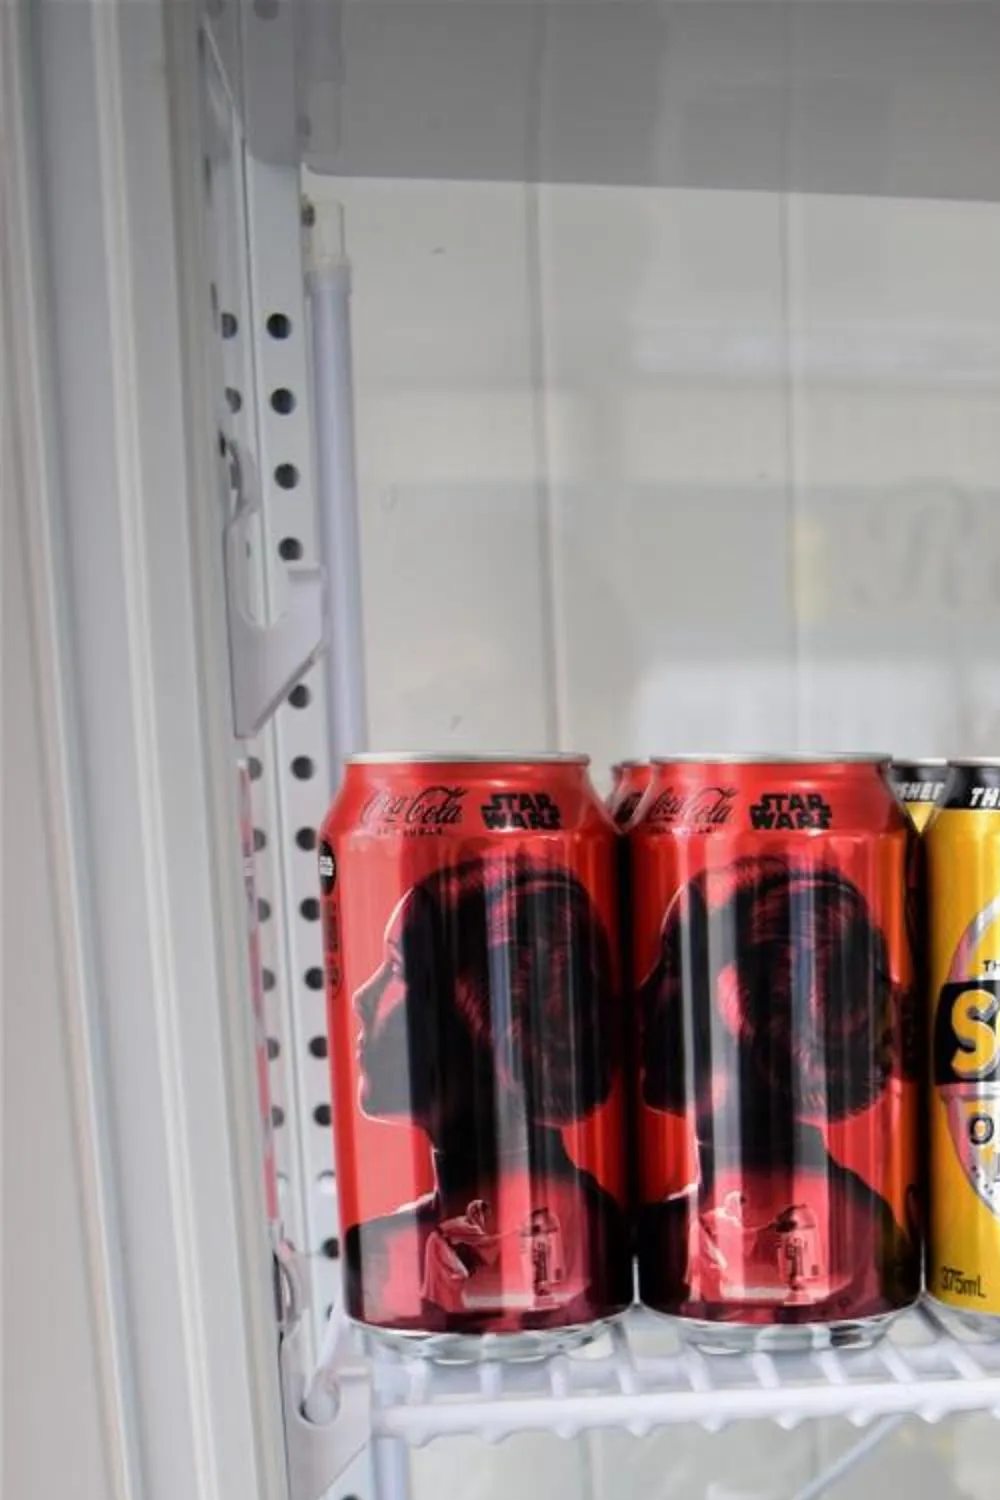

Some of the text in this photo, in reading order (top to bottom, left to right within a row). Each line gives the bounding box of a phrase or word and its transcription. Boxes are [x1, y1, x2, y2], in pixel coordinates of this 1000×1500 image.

[489, 793, 556, 809] STAR
[761, 793, 824, 810] STAR
[480, 804, 562, 831] WARS
[749, 804, 833, 831] WARS
[941, 1265, 987, 1298] 375mL
